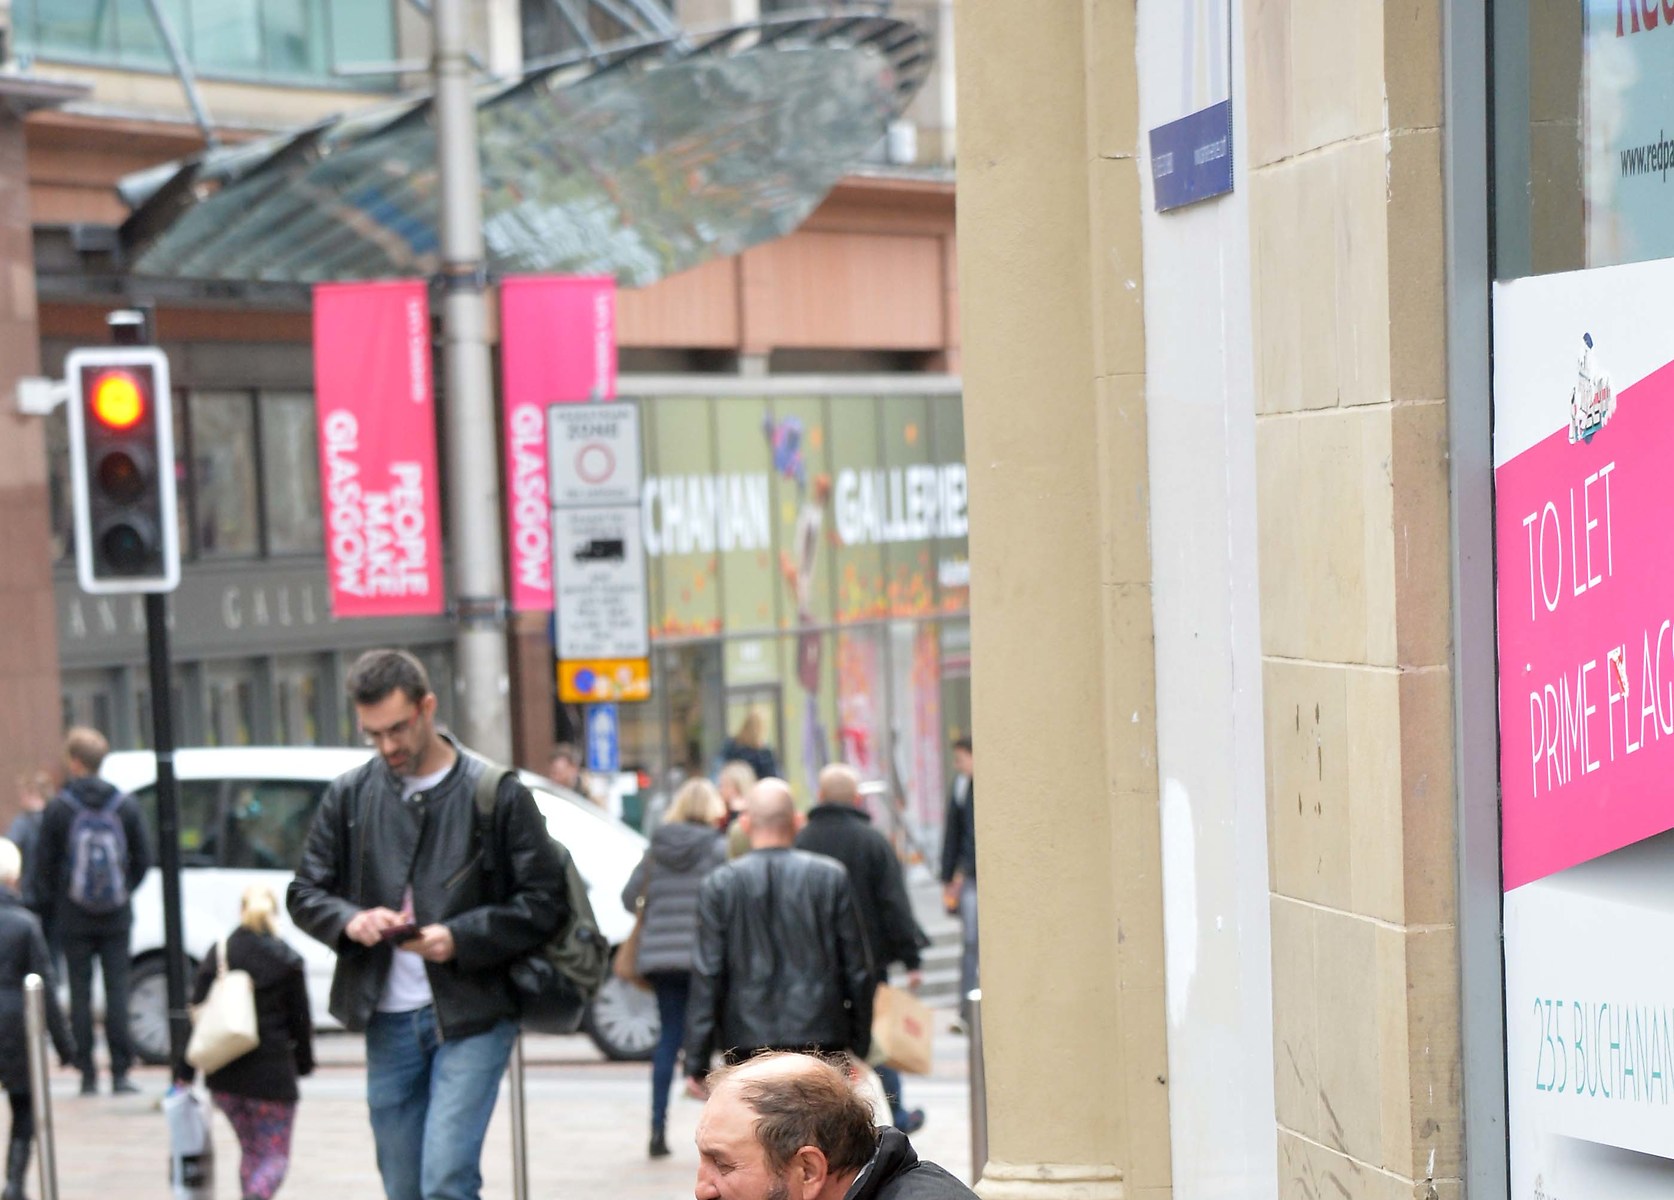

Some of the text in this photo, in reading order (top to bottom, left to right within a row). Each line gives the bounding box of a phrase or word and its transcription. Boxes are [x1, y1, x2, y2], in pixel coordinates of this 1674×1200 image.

[325, 409, 365, 597] GLASGOW
[363, 491, 406, 597] MAKE
[389, 462, 429, 596] PEOPLE
[511, 402, 551, 592] GLASGOW
[1522, 461, 1616, 622] TO LET
[221, 584, 337, 631] GALL
[1529, 619, 1674, 799] PRIME FLAG
[1533, 997, 1674, 1106] 235 BUCHANAN
